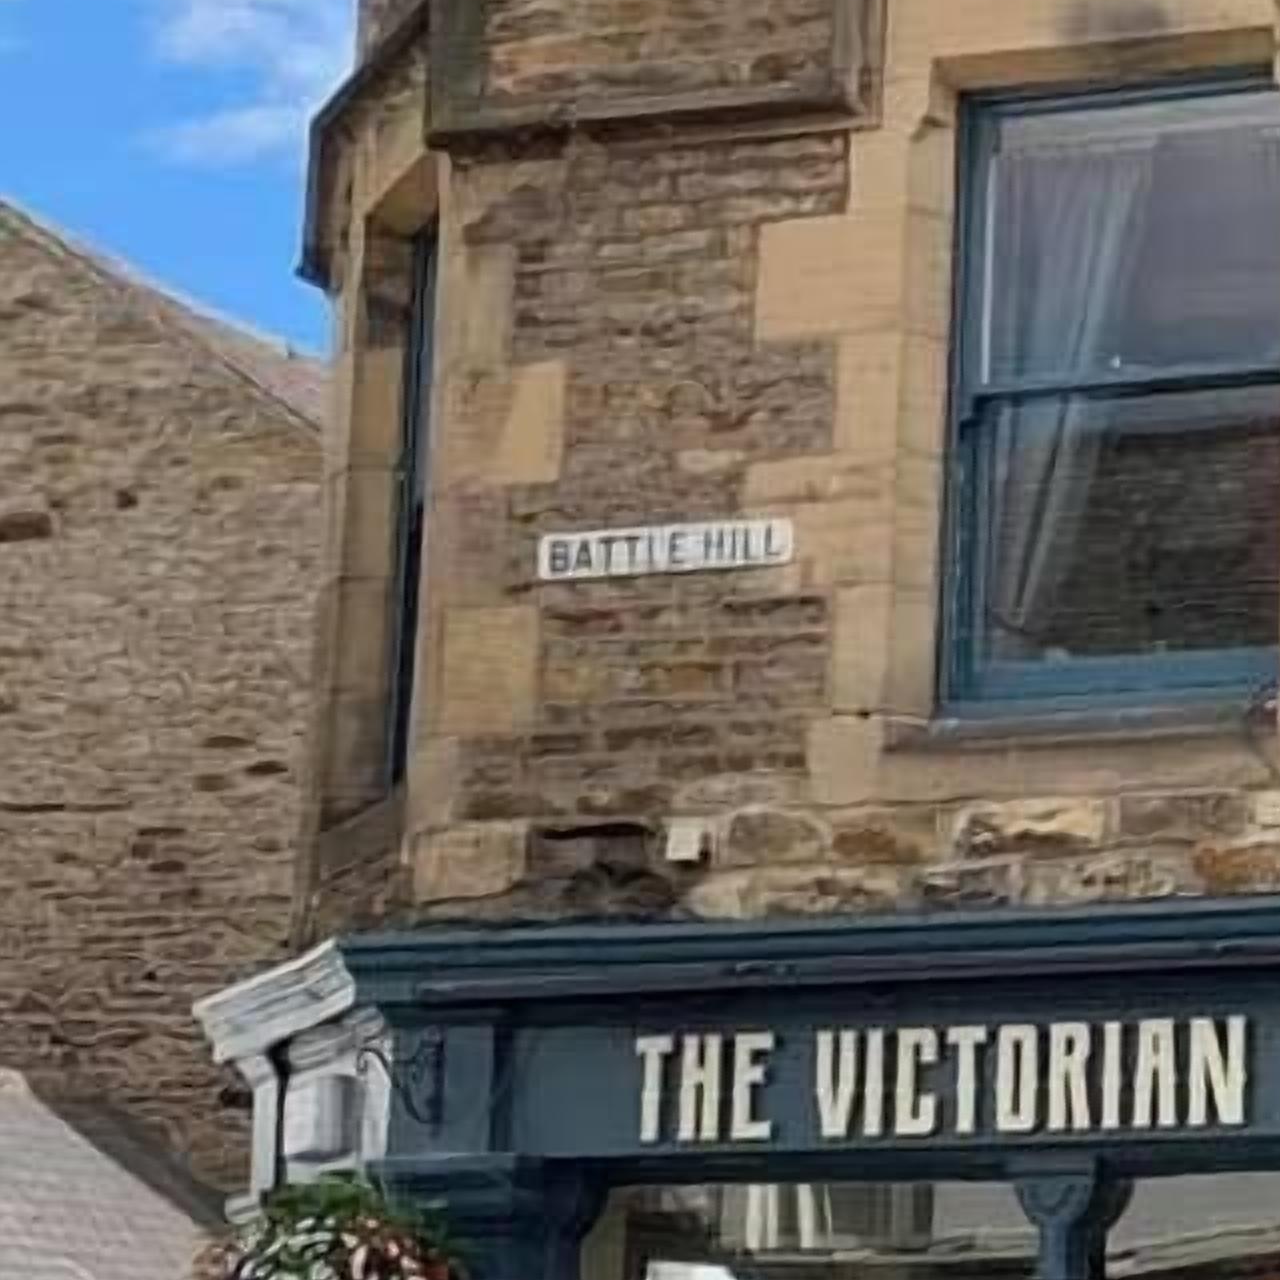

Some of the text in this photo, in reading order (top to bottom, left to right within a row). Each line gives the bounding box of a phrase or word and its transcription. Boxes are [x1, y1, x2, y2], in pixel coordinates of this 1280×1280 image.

[702, 523, 781, 562] HILL
[635, 1032, 776, 1143] THE
[815, 1014, 1248, 1137] VICTORIAN
